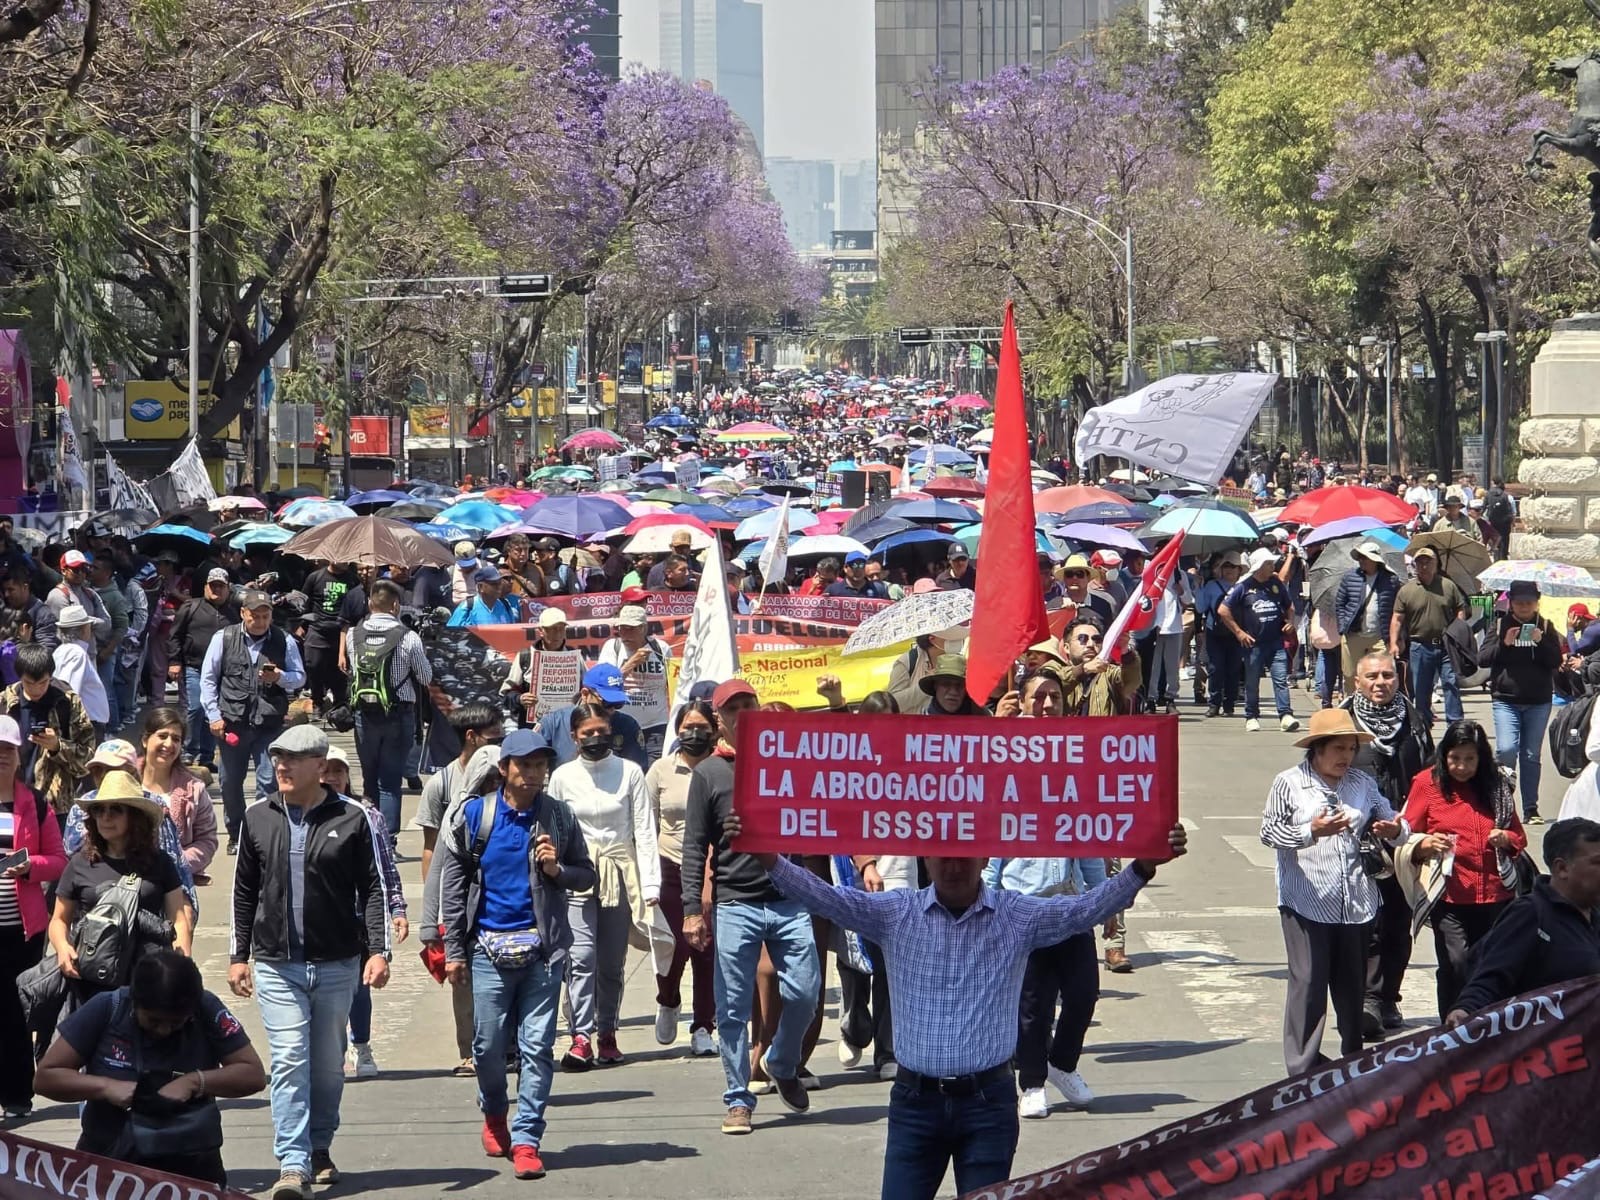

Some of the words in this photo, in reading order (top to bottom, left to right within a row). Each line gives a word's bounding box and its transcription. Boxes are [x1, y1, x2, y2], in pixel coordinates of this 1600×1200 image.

[168, 397, 217, 409] merad
[168, 410, 190, 422] pag
[757, 596, 840, 609] RABAJADORES
[542, 668, 577, 676] REFORMA
[757, 654, 829, 672] Nacional
[542, 675, 577, 684] EDUCATIVA
[758, 729, 882, 765] CLAUDIA,
[905, 734, 1085, 763] MENTISSSTE
[1101, 735, 1156, 763] CON
[759, 768, 795, 797] LA
[811, 766, 984, 802] ABROGACIÓN
[1002, 774, 1019, 802] A
[1041, 774, 1079, 802] LA
[1098, 774, 1153, 802] LEY
[780, 808, 837, 837] DEL
[862, 810, 975, 840] ISSSTE
[1001, 813, 1038, 841] DE
[1055, 813, 1133, 841] 2007
[1188, 1121, 1339, 1186] UMA
[1414, 1034, 1590, 1120] AFORE
[1443, 1114, 1495, 1158] al
